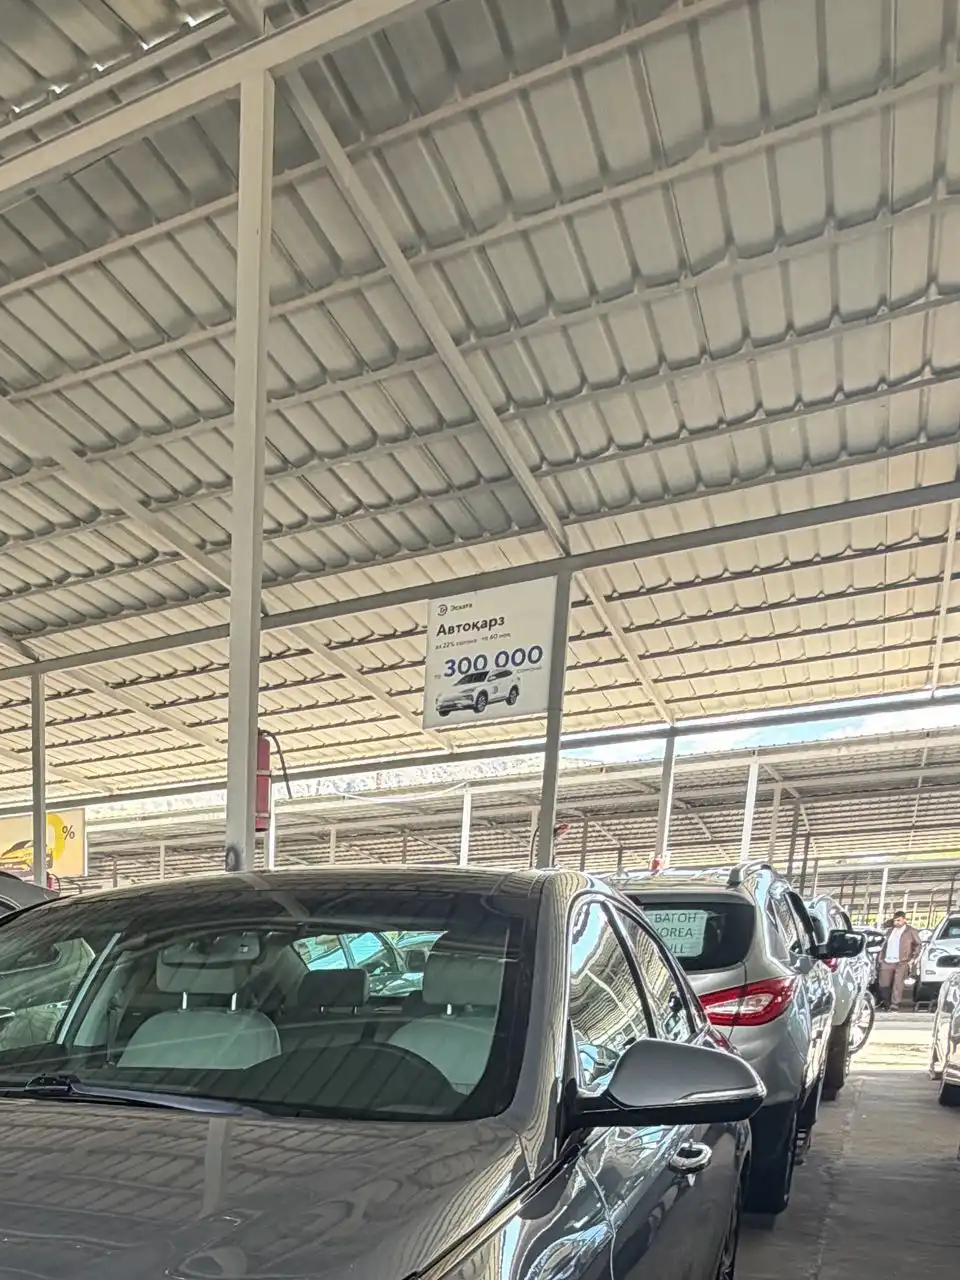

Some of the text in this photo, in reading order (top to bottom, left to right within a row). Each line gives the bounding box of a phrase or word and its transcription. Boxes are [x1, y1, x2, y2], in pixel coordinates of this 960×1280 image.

[436, 616, 505, 637] Автоқарз
[444, 654, 488, 678] 300
[495, 645, 543, 668] 000
[654, 913, 697, 923] ВАГОН
